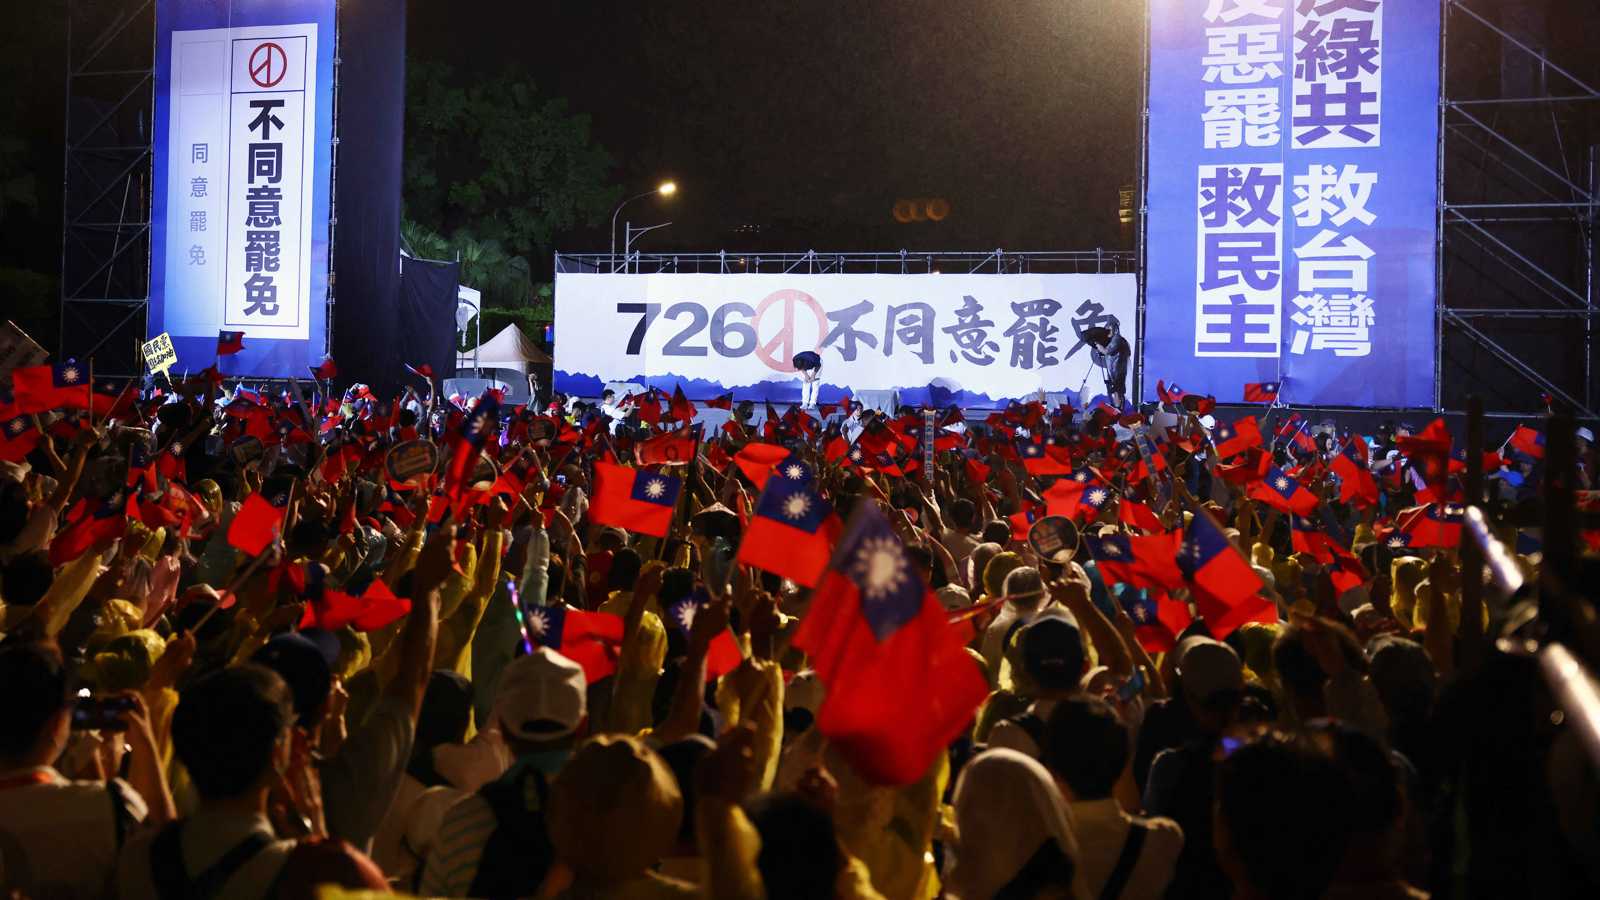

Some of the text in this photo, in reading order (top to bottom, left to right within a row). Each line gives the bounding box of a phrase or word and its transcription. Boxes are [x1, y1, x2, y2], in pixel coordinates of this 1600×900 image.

[189, 143, 209, 266] 同意罷免
[243, 99, 285, 317] 不同意罷免
[1198, 167, 1282, 353] 救民主
[1290, 164, 1378, 357] 救台灣
[617, 302, 758, 358] 726
